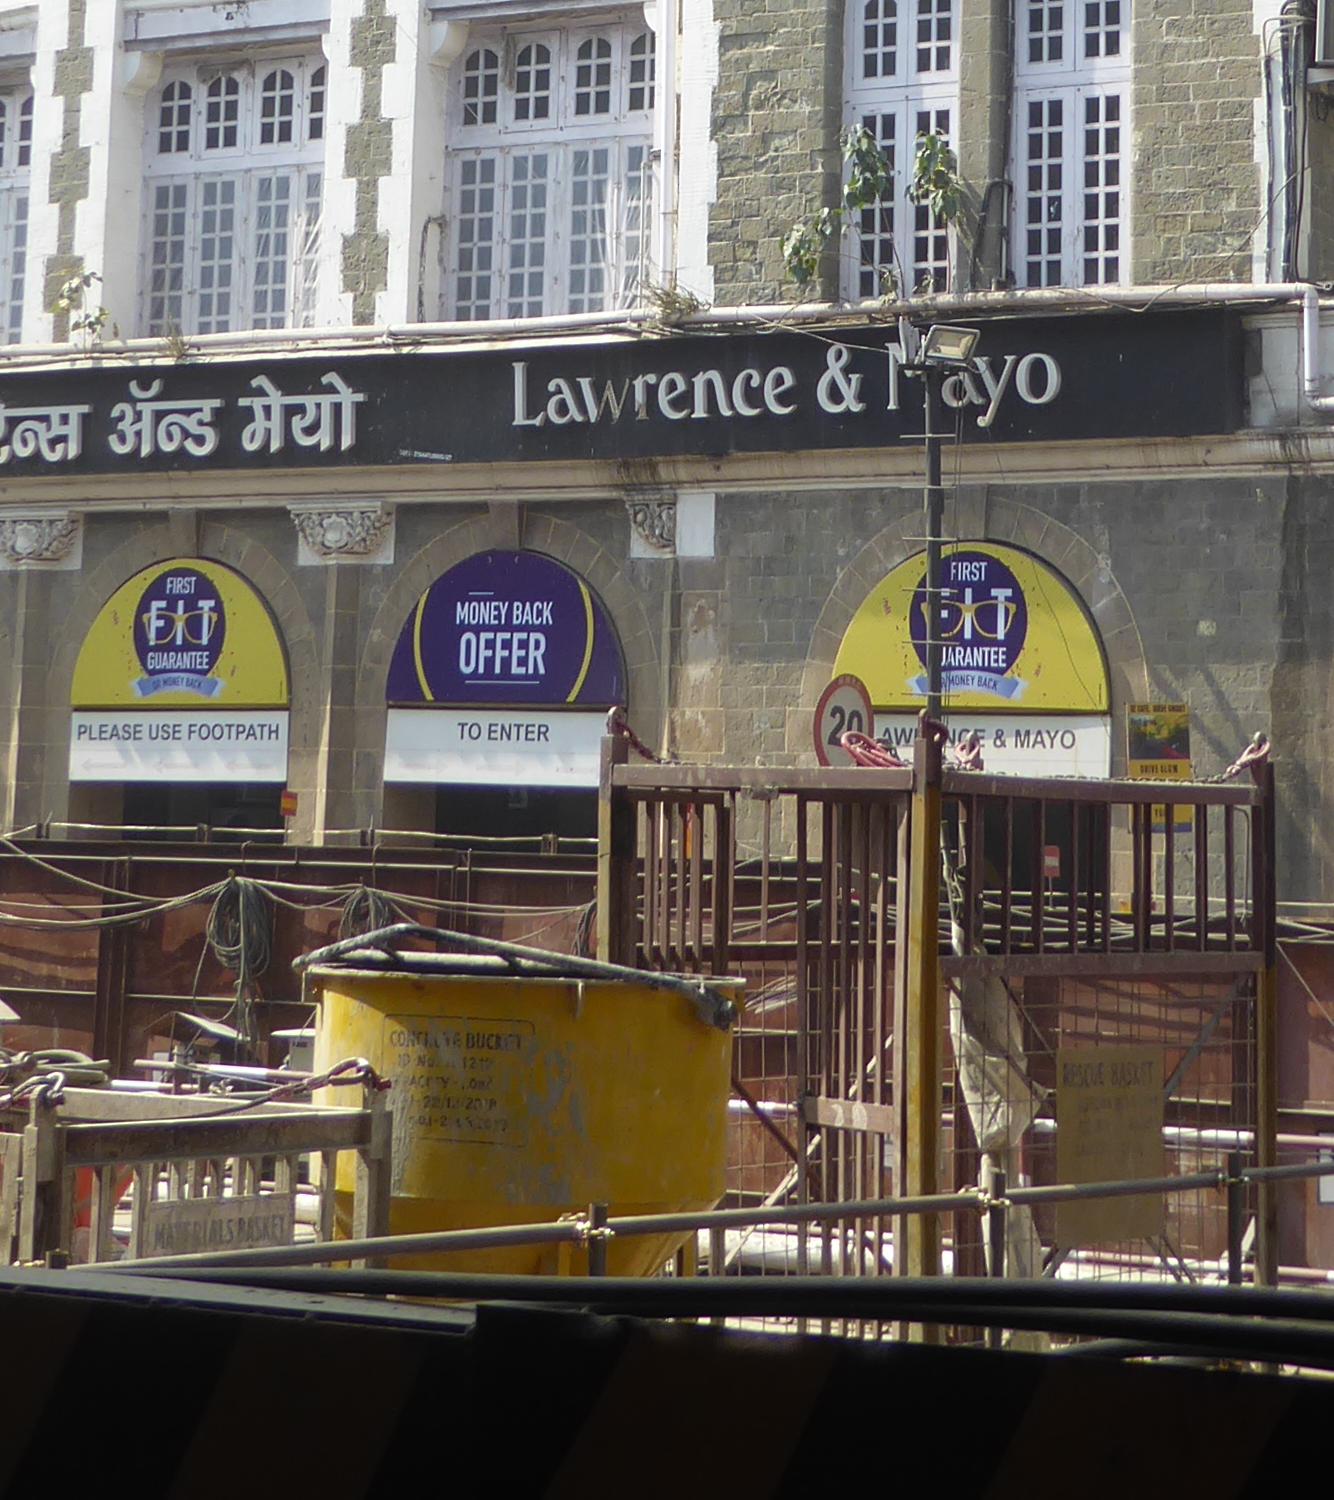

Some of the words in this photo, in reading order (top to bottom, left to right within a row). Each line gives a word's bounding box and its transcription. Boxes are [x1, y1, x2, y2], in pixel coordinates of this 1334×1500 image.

[511, 361, 799, 427] Lawrence
[816, 343, 866, 413] &
[238, 371, 365, 454] मेयो
[950, 561, 988, 582] FIRST
[166, 576, 197, 594] FIRST
[148, 599, 216, 646] FIT
[456, 600, 509, 626] MONEY
[512, 600, 554, 626] BACK
[147, 651, 210, 670] GUARANTEE
[459, 631, 547, 675] OFFER
[941, 646, 1007, 668] UARANTEE
[162, 677, 184, 688] MONEY
[185, 678, 203, 690] BACK
[949, 675, 975, 688] MONEY
[977, 676, 999, 691] BACK
[77, 723, 143, 741] PLEASE
[148, 723, 183, 741] USE
[187, 723, 280, 741] FOOTPATH
[457, 722, 482, 740] TO
[487, 722, 550, 742] ENTER
[827, 705, 864, 747] 20
[993, 728, 1007, 749] &
[1014, 729, 1076, 750] MAYO
